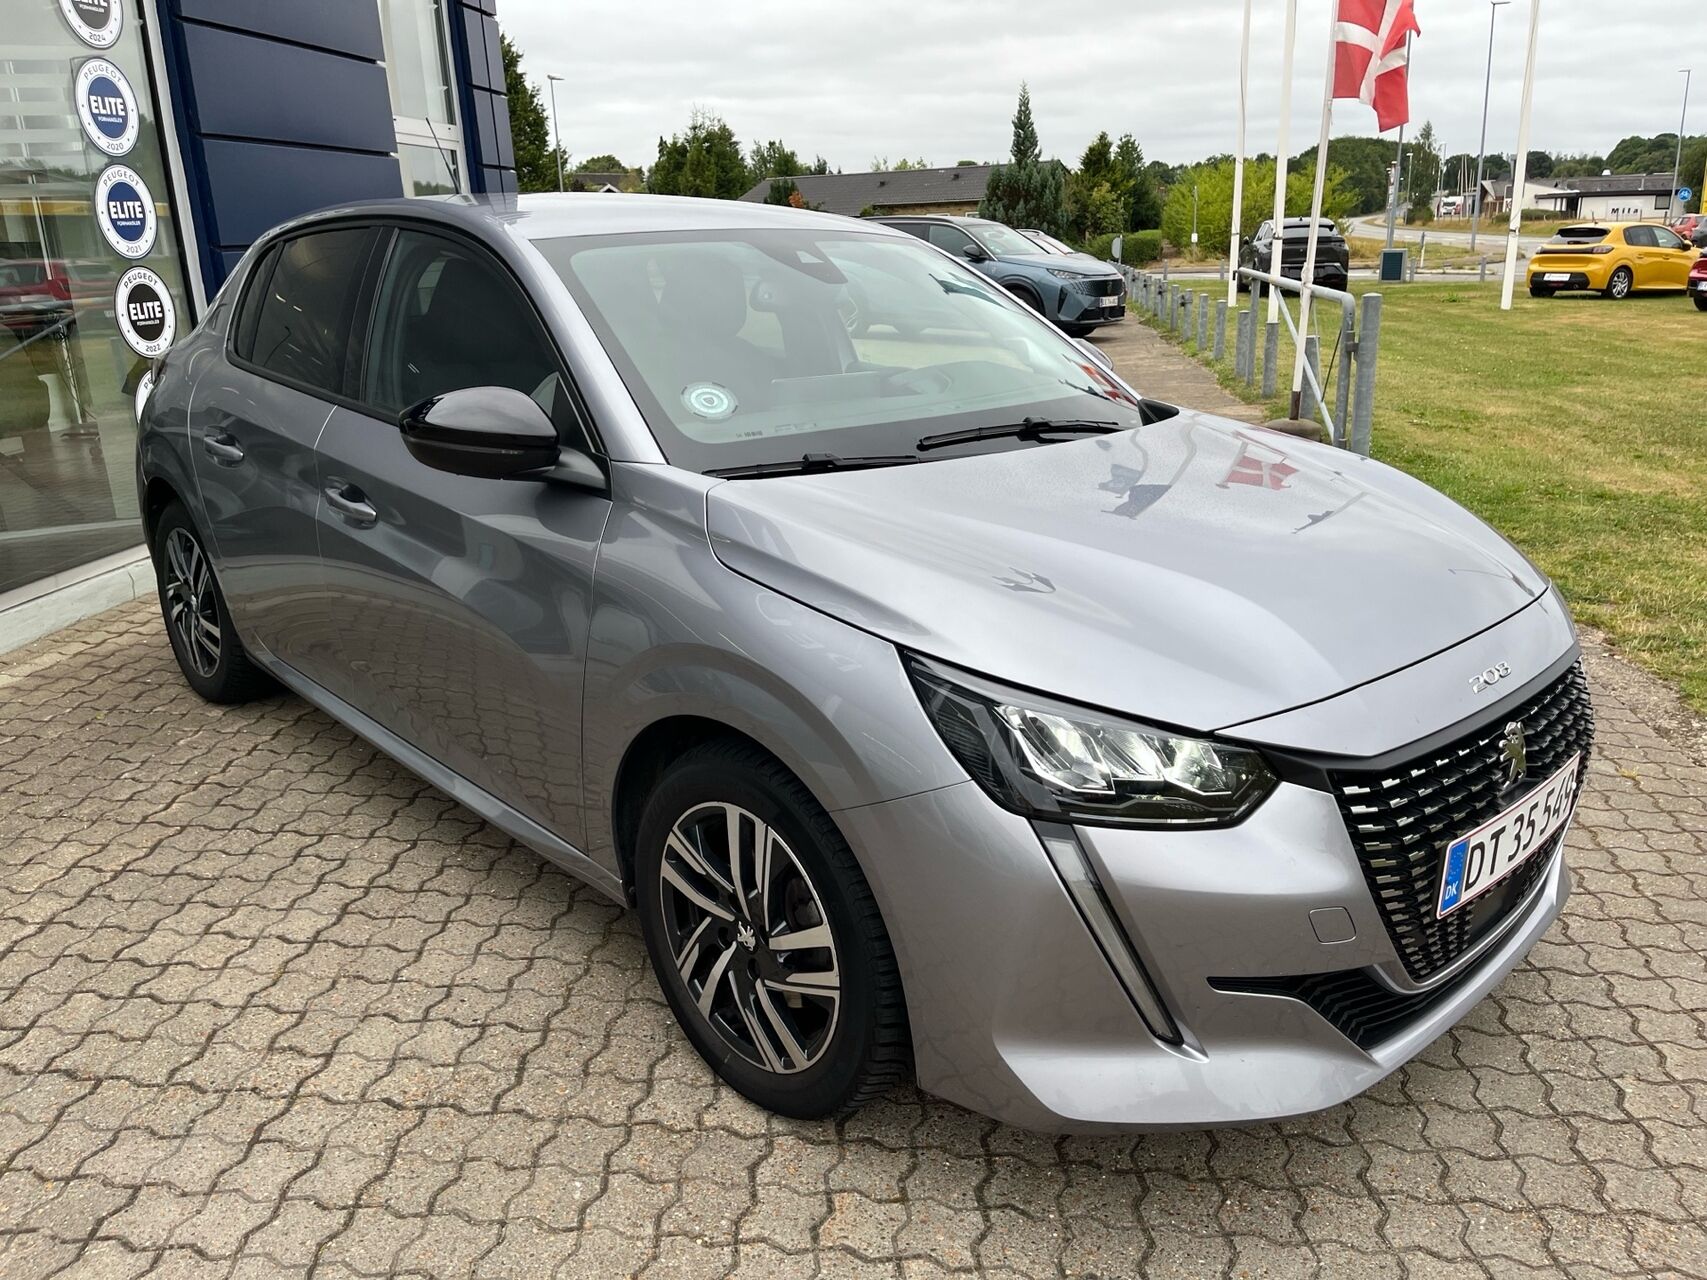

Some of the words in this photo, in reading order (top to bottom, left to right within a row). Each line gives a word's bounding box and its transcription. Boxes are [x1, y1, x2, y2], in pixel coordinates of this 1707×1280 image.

[84, 64, 121, 82] PEUGEOT
[89, 95, 126, 116] ELITE
[103, 169, 139, 187] PEUGEOT
[109, 201, 144, 219] ELITE
[123, 272, 158, 288] PEUGEOT
[129, 301, 162, 320] ELITE
[145, 343, 161, 352] 2022
[1468, 662, 1511, 694] 208
[1464, 825, 1506, 892] DT
[1507, 801, 1540, 863] 35
[1539, 769, 1574, 836] 549
[1445, 881, 1459, 900] DK
